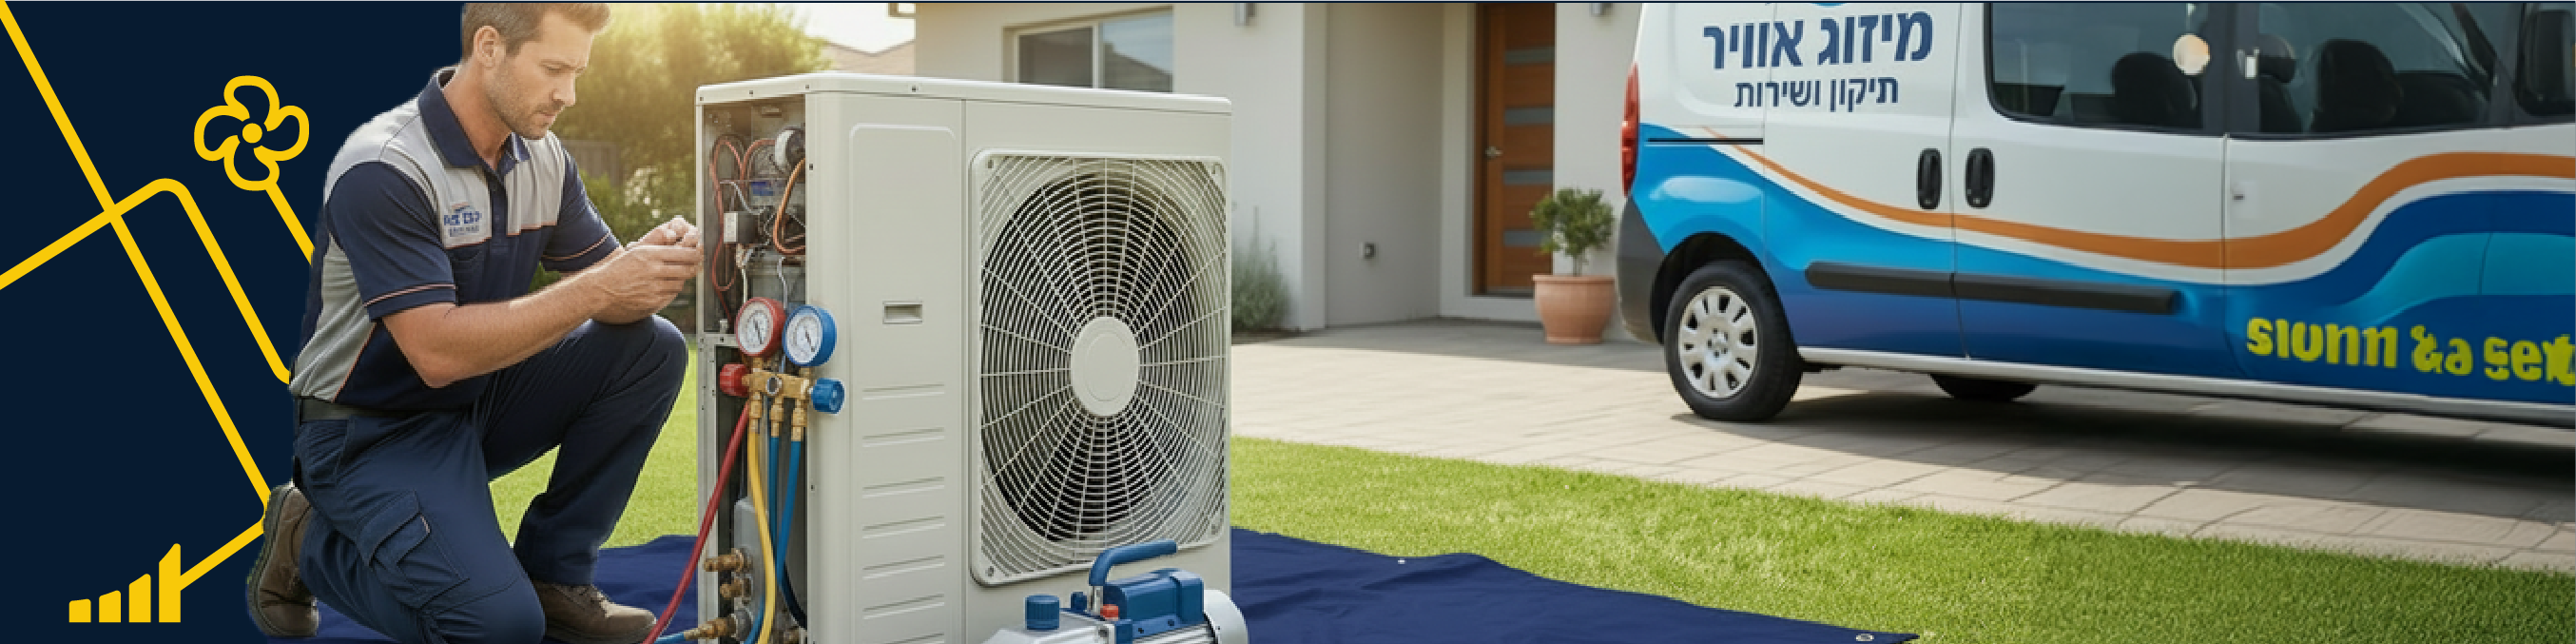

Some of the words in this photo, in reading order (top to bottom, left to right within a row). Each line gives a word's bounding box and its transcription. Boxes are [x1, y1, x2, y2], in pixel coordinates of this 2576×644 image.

[1703, 19, 1804, 69] אוויר
[1817, 11, 1933, 66] מיזוג
[1733, 81, 1821, 107] ושירות
[1830, 77, 1898, 112] תיקון
